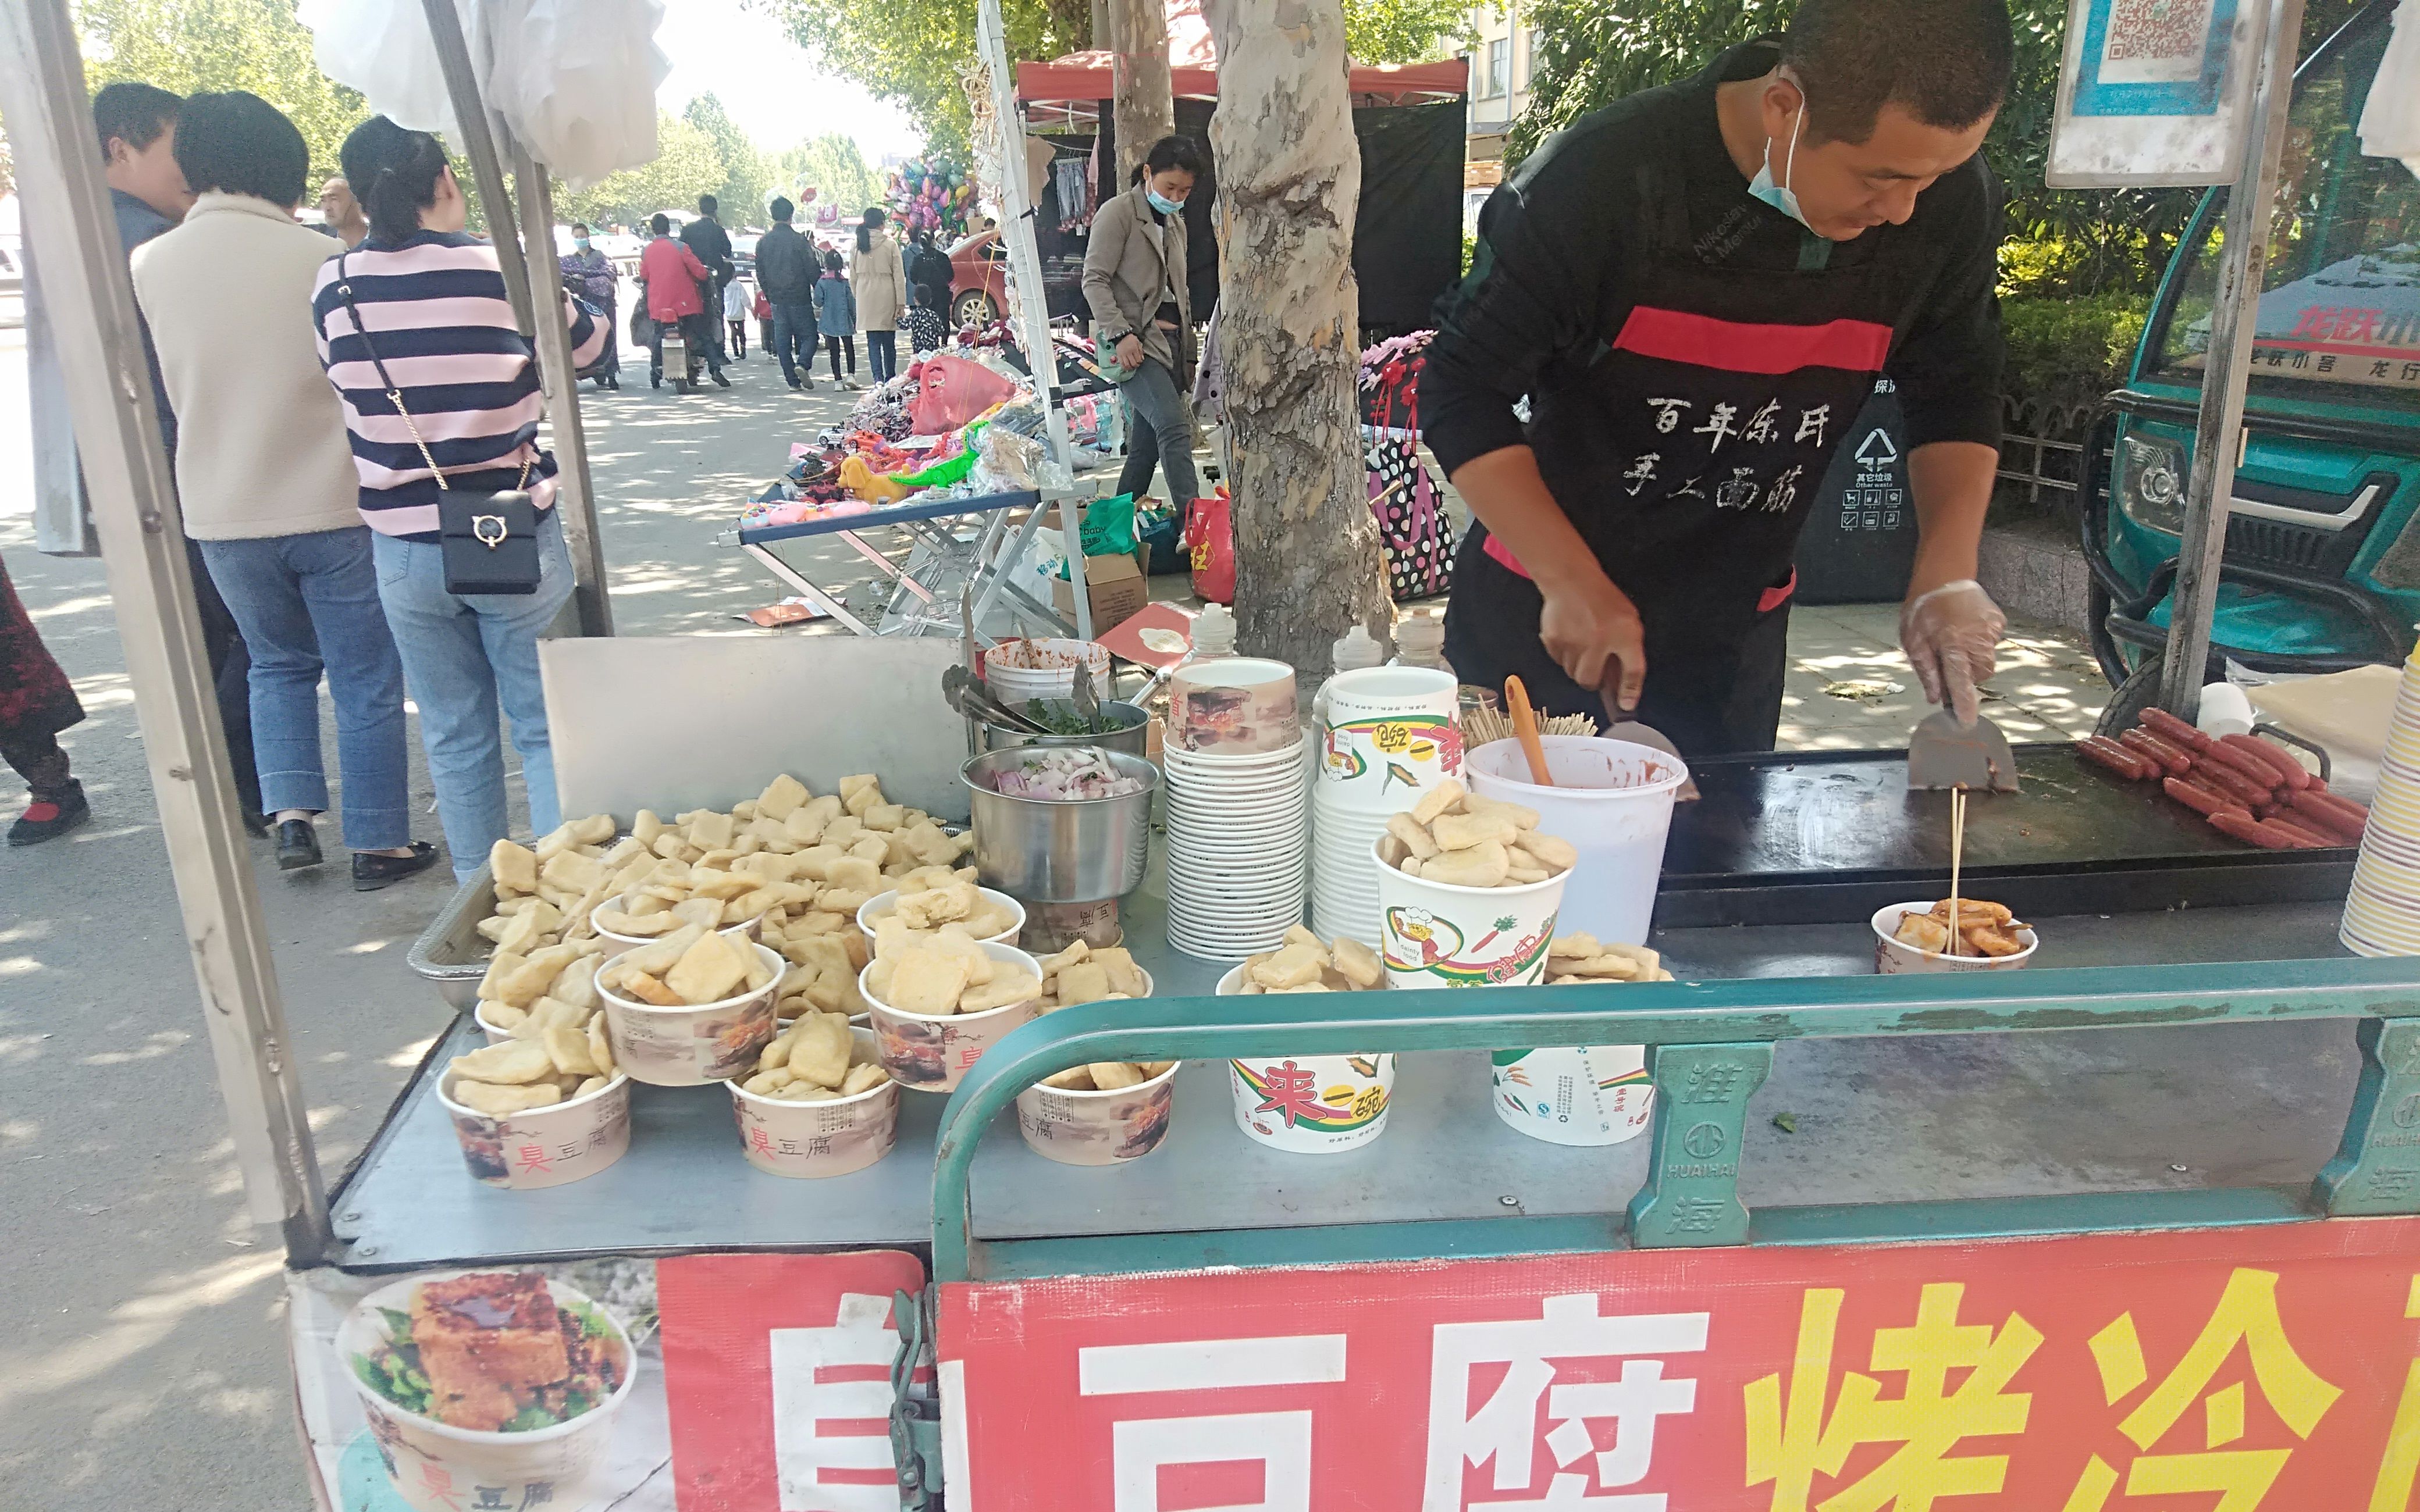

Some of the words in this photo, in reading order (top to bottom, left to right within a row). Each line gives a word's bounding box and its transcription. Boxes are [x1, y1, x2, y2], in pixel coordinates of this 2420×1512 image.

[1856, 473, 1892, 482] 其它垃圾
[1400, 944, 1419, 957] dainty
[1403, 951, 1418, 962] food
[1255, 1060, 1381, 1129] 来一碗
[1680, 1063, 1743, 1104] 淮
[515, 1123, 607, 1174] 臭豆腐
[750, 1126, 833, 1160] 臭豆腐
[1667, 1163, 1736, 1179] HUAIHAI
[1664, 1196, 1725, 1235] 海
